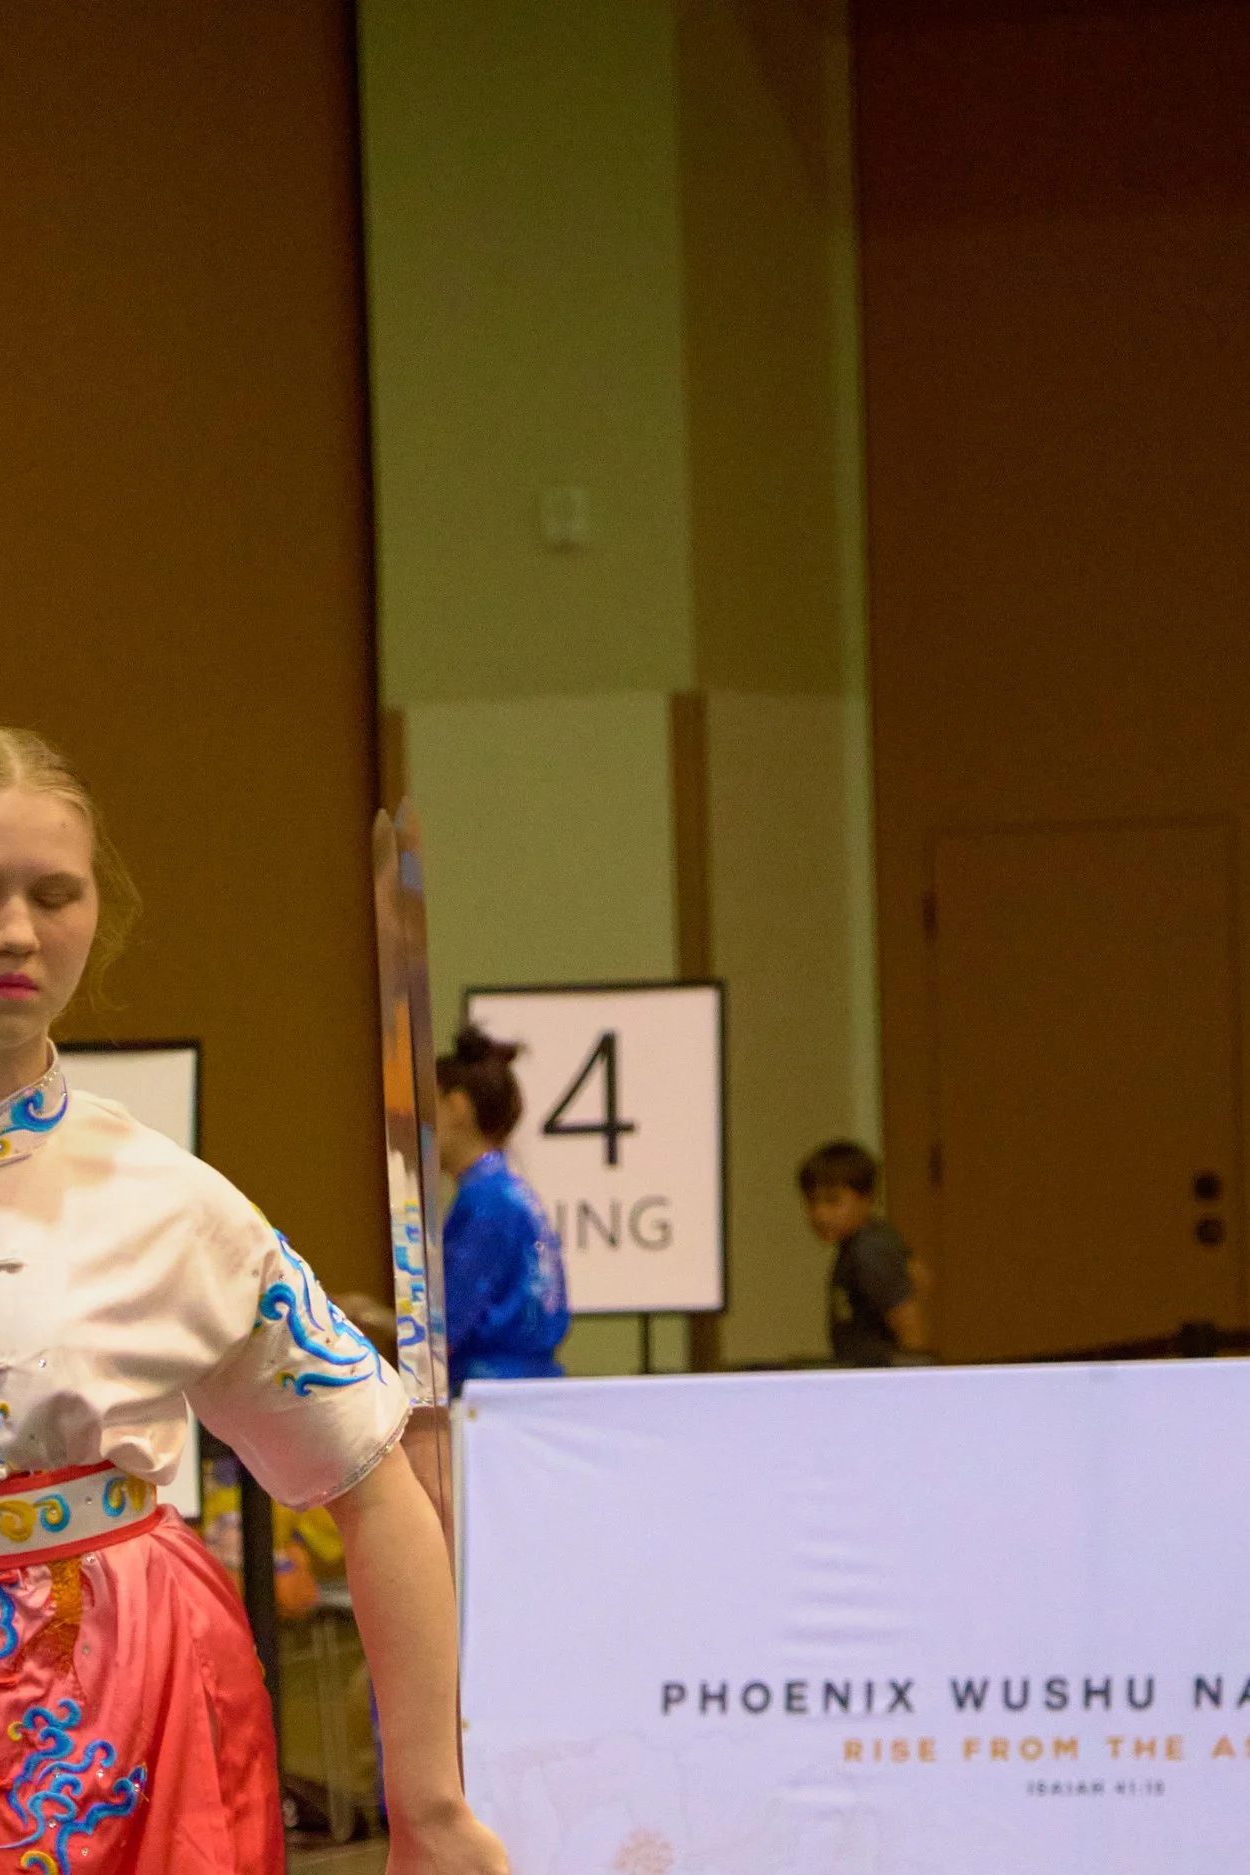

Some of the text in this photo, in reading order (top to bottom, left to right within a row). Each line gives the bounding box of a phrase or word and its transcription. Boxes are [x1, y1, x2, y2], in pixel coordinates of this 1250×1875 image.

[541, 1030, 636, 1166] 4
[554, 1194, 674, 1251] ING
[661, 1676, 917, 1715] PHOENIX
[950, 1674, 1154, 1712] WUSHU
[843, 1734, 1250, 1764] RISE FROM THE A
